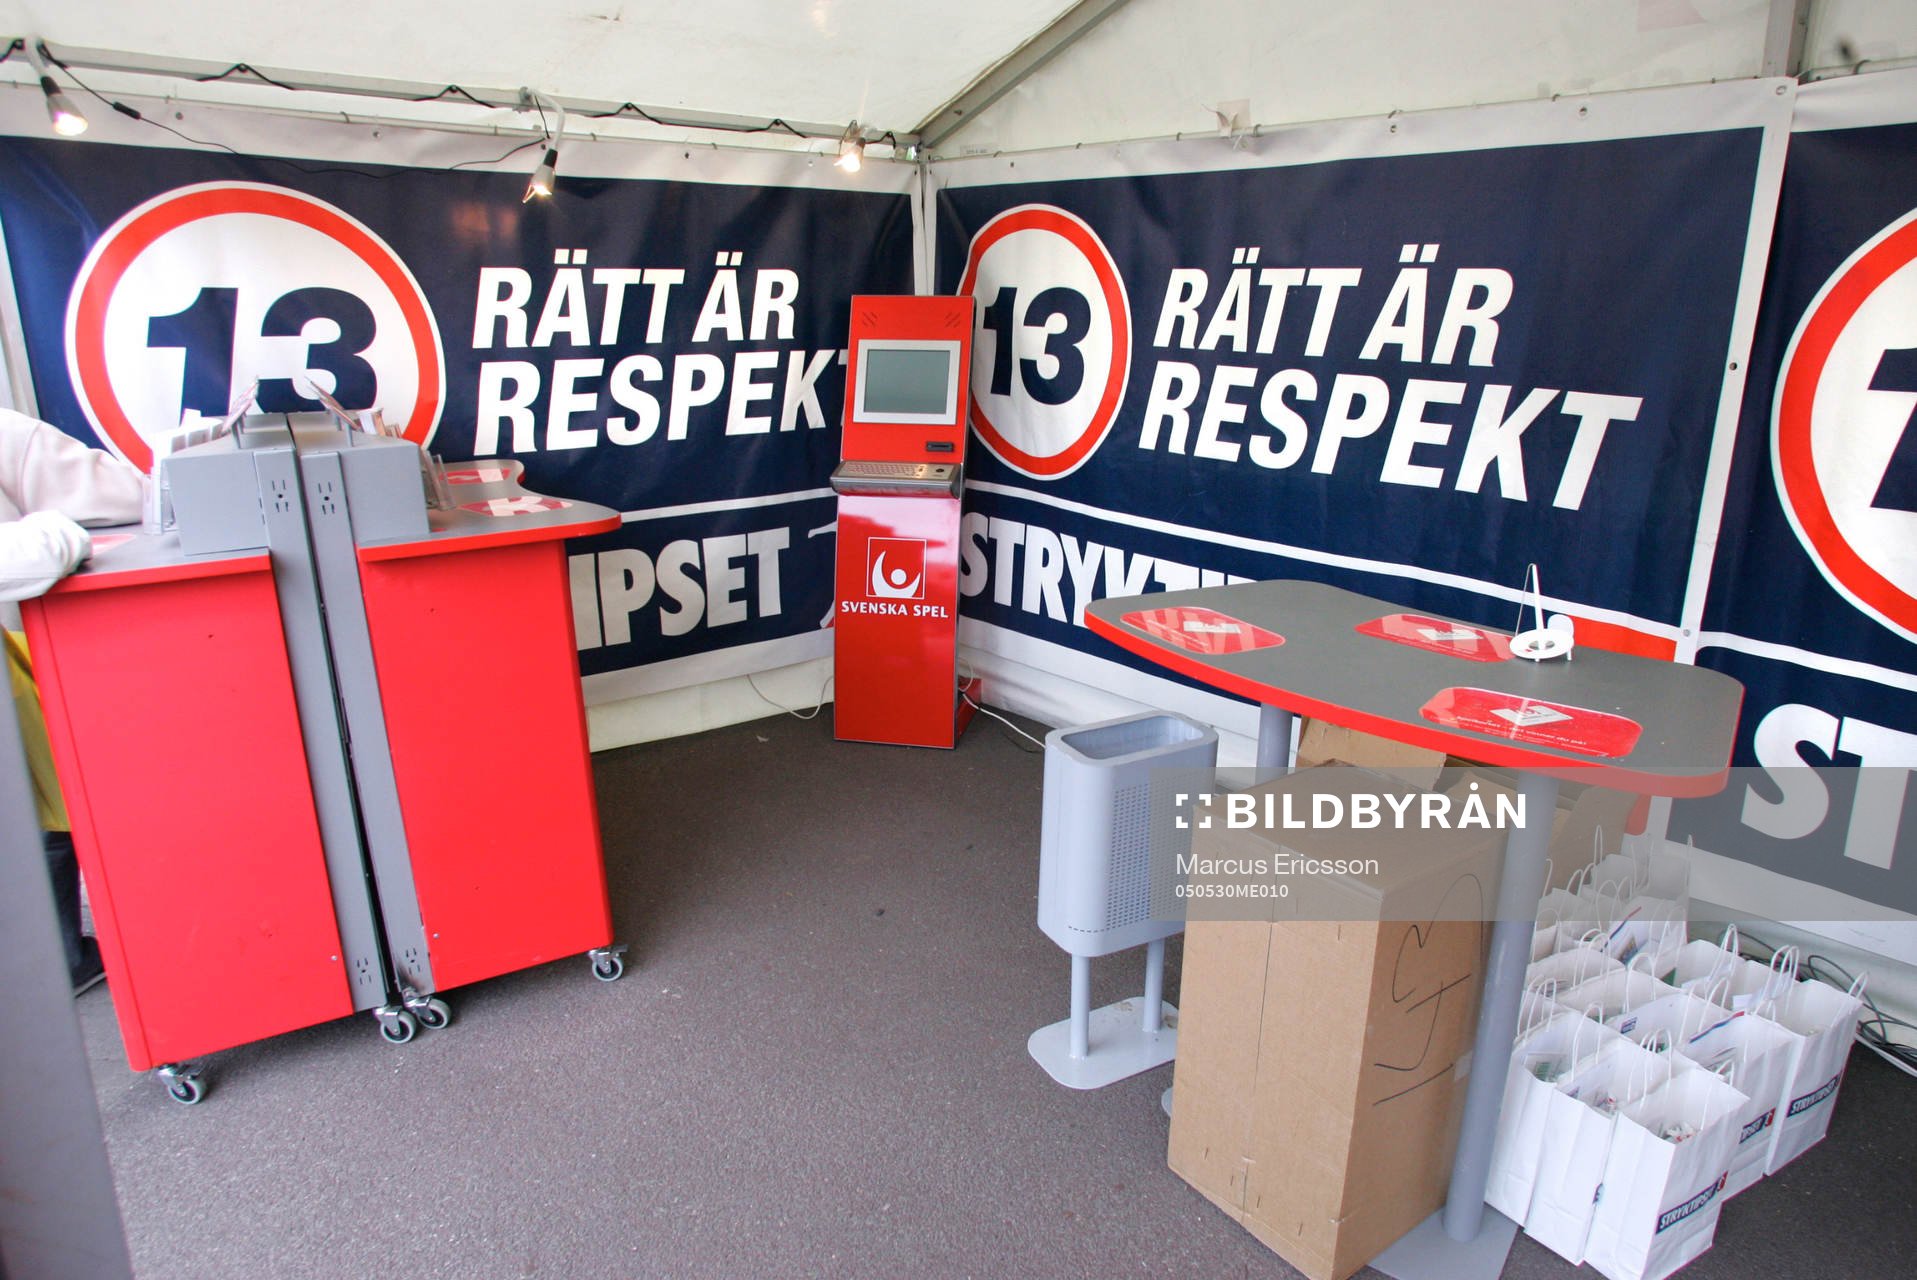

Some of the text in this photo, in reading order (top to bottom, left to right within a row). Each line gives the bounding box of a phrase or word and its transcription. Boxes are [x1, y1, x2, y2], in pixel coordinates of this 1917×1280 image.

[146, 286, 378, 425] 13
[472, 248, 800, 349] RÄTT ÄR
[981, 286, 1092, 406] 13
[1153, 243, 1515, 368] RÄTT ÄR
[1138, 360, 1644, 511] RESPEKT
[568, 526, 790, 652] IPSET
[841, 601, 949, 619] SVENSKA SPEL
[1740, 703, 1917, 870] ST
